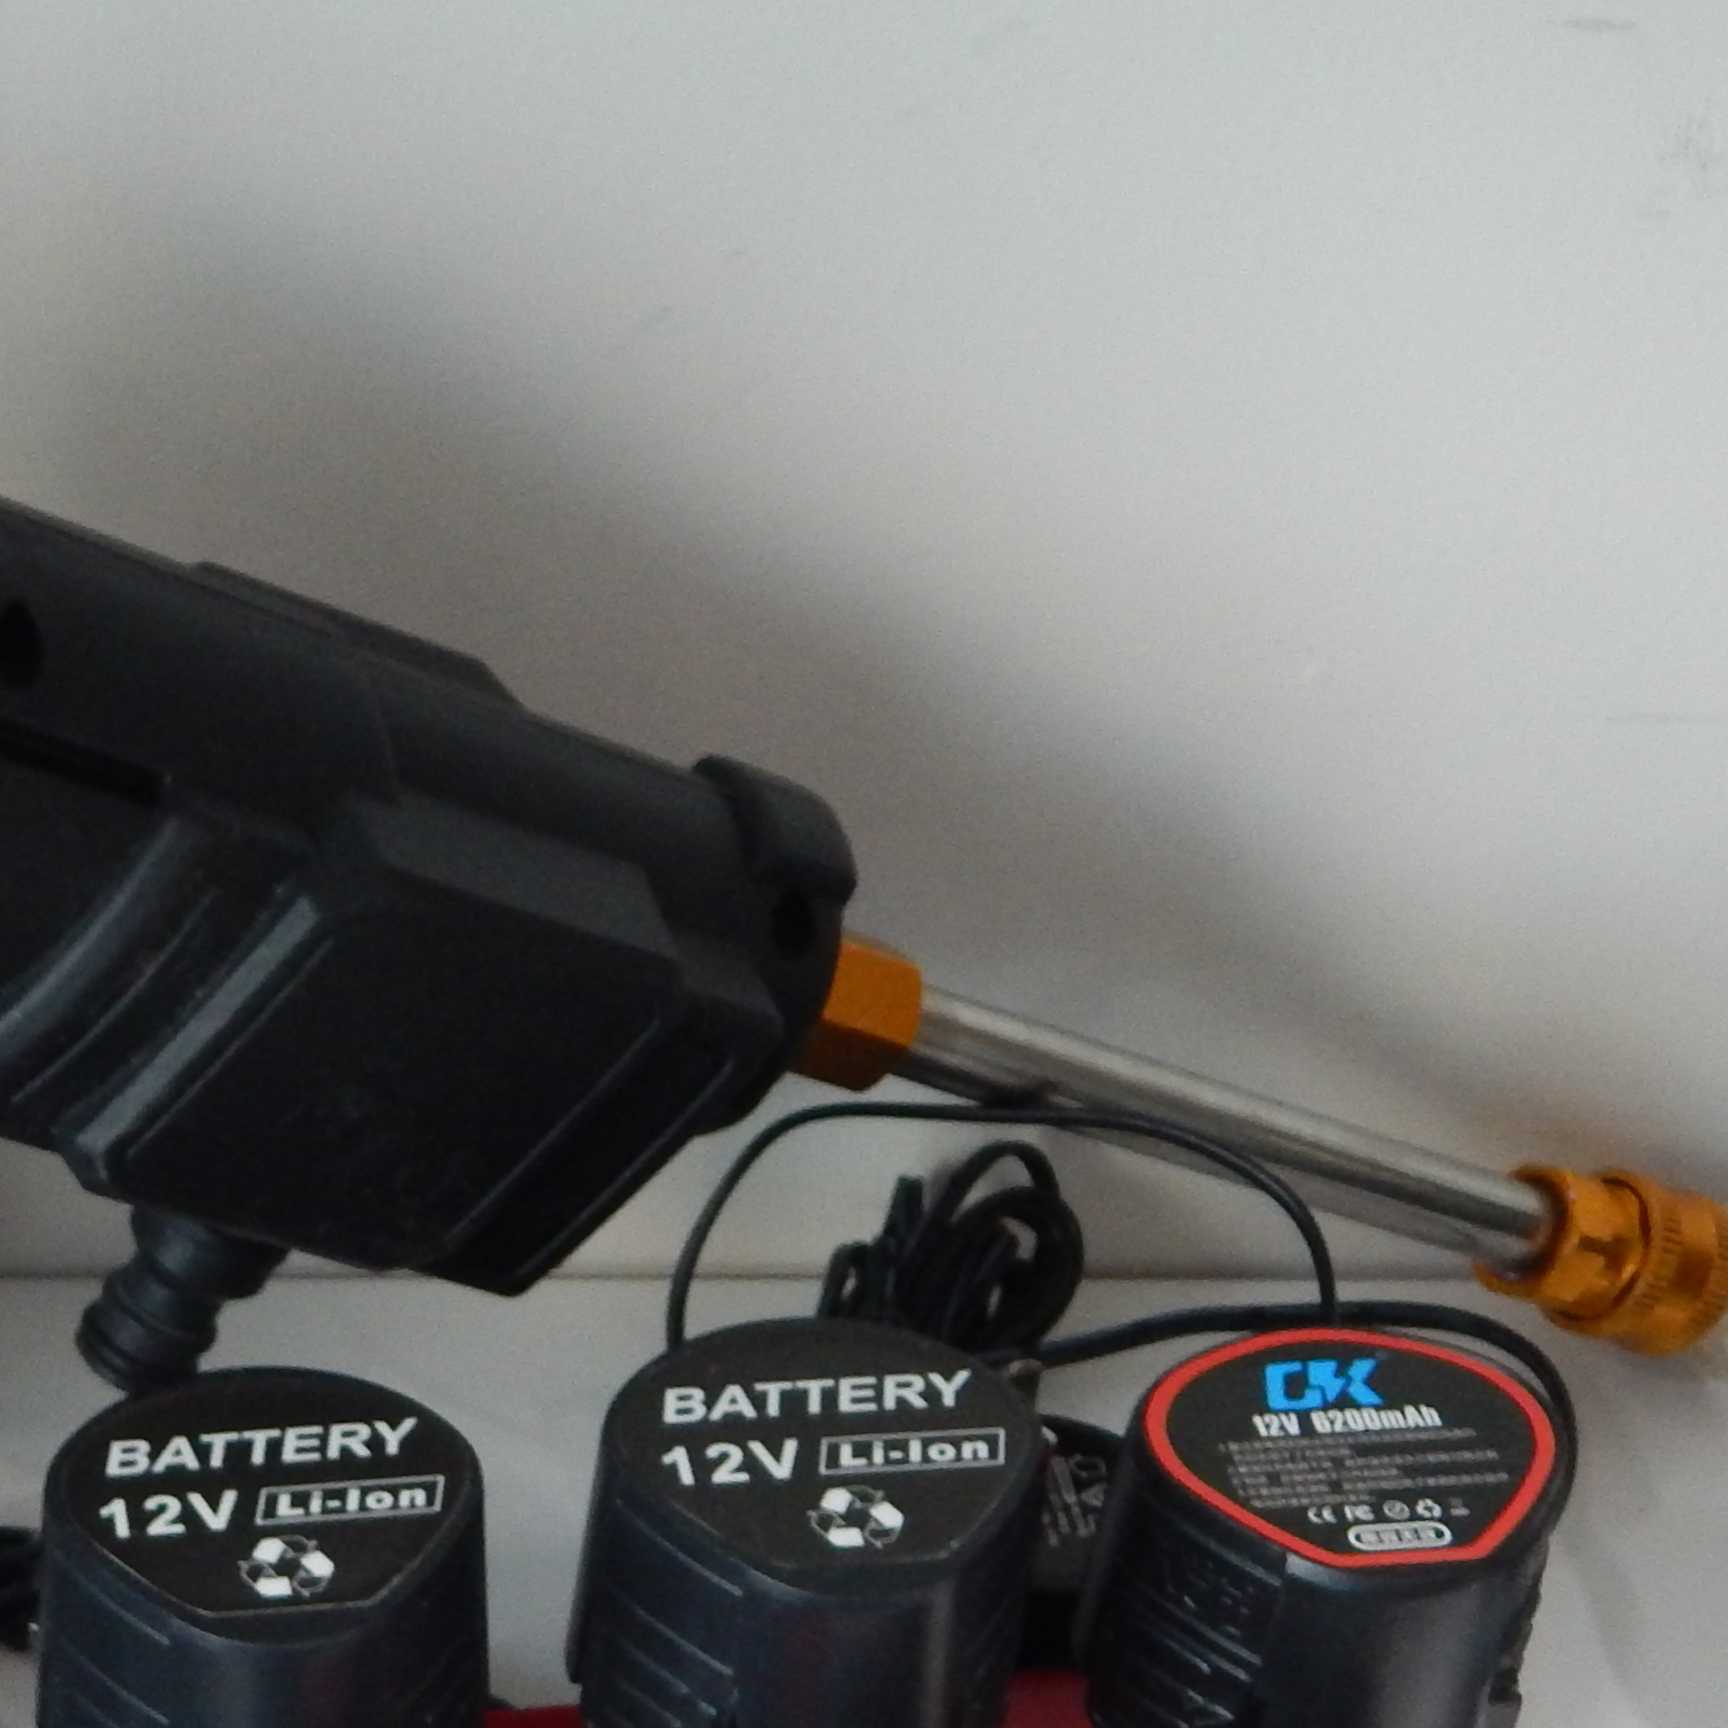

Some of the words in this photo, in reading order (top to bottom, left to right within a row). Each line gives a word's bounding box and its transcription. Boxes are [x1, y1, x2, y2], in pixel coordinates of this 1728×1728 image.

[661, 1369, 972, 1425] BATTERY
[105, 1416, 418, 1478] BATTERY
[1251, 1411, 1302, 1438] 12V
[660, 1437, 799, 1487] 12V
[98, 1488, 239, 1540] 12V
